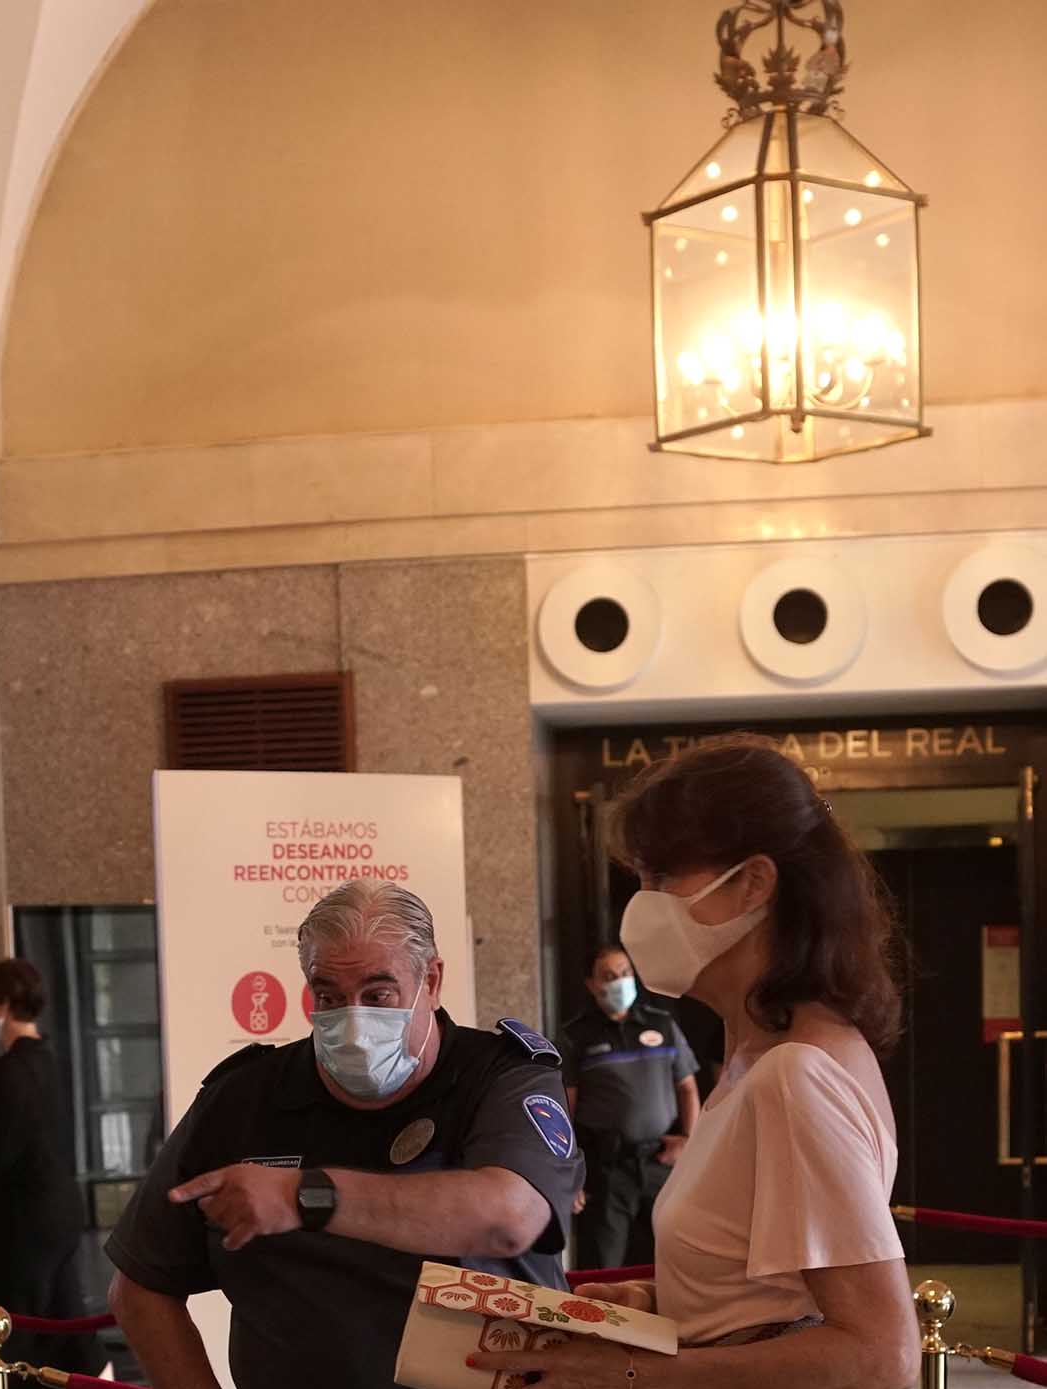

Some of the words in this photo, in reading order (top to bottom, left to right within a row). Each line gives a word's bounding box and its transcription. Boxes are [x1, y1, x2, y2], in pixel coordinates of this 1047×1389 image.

[602, 737, 652, 767] LA
[819, 729, 892, 759] DEL
[905, 726, 1007, 757] REAL
[266, 818, 378, 839] ESTÁBAMOS
[272, 843, 373, 860] DESEANDO
[233, 865, 409, 881] REENCONTRARNOS
